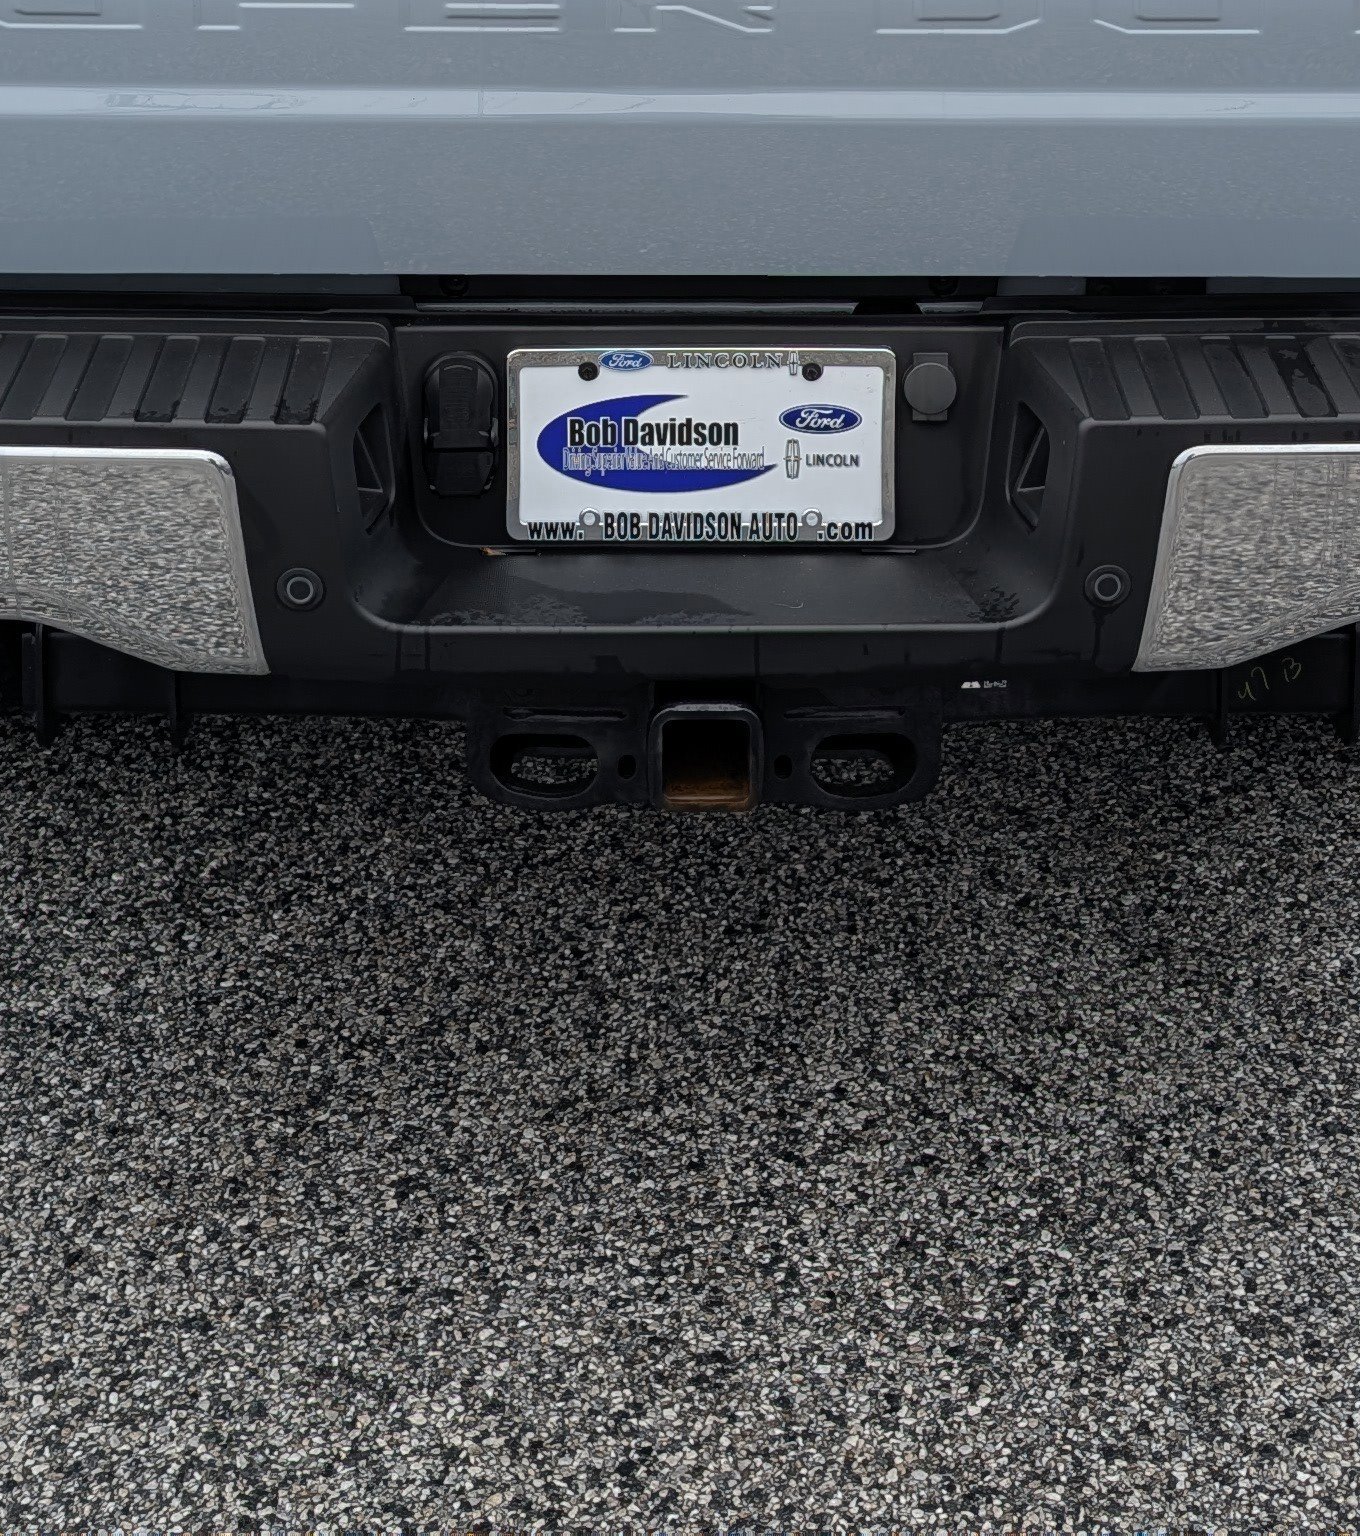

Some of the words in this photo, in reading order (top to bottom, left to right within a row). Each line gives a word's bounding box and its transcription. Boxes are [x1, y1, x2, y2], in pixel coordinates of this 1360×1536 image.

[608, 352, 643, 369] Ford
[667, 352, 785, 369] LINCOLN
[795, 408, 846, 430] Ford
[569, 417, 617, 447] Bob
[623, 417, 740, 447] Davidson
[563, 448, 591, 476] Driving
[666, 448, 703, 471] Customer
[704, 448, 731, 471] Service
[733, 447, 765, 471] Forward
[805, 453, 859, 468] LINCOLN
[603, 512, 640, 541] BOB
[648, 512, 740, 541] DAVIDSON
[749, 512, 798, 541] AUTO
